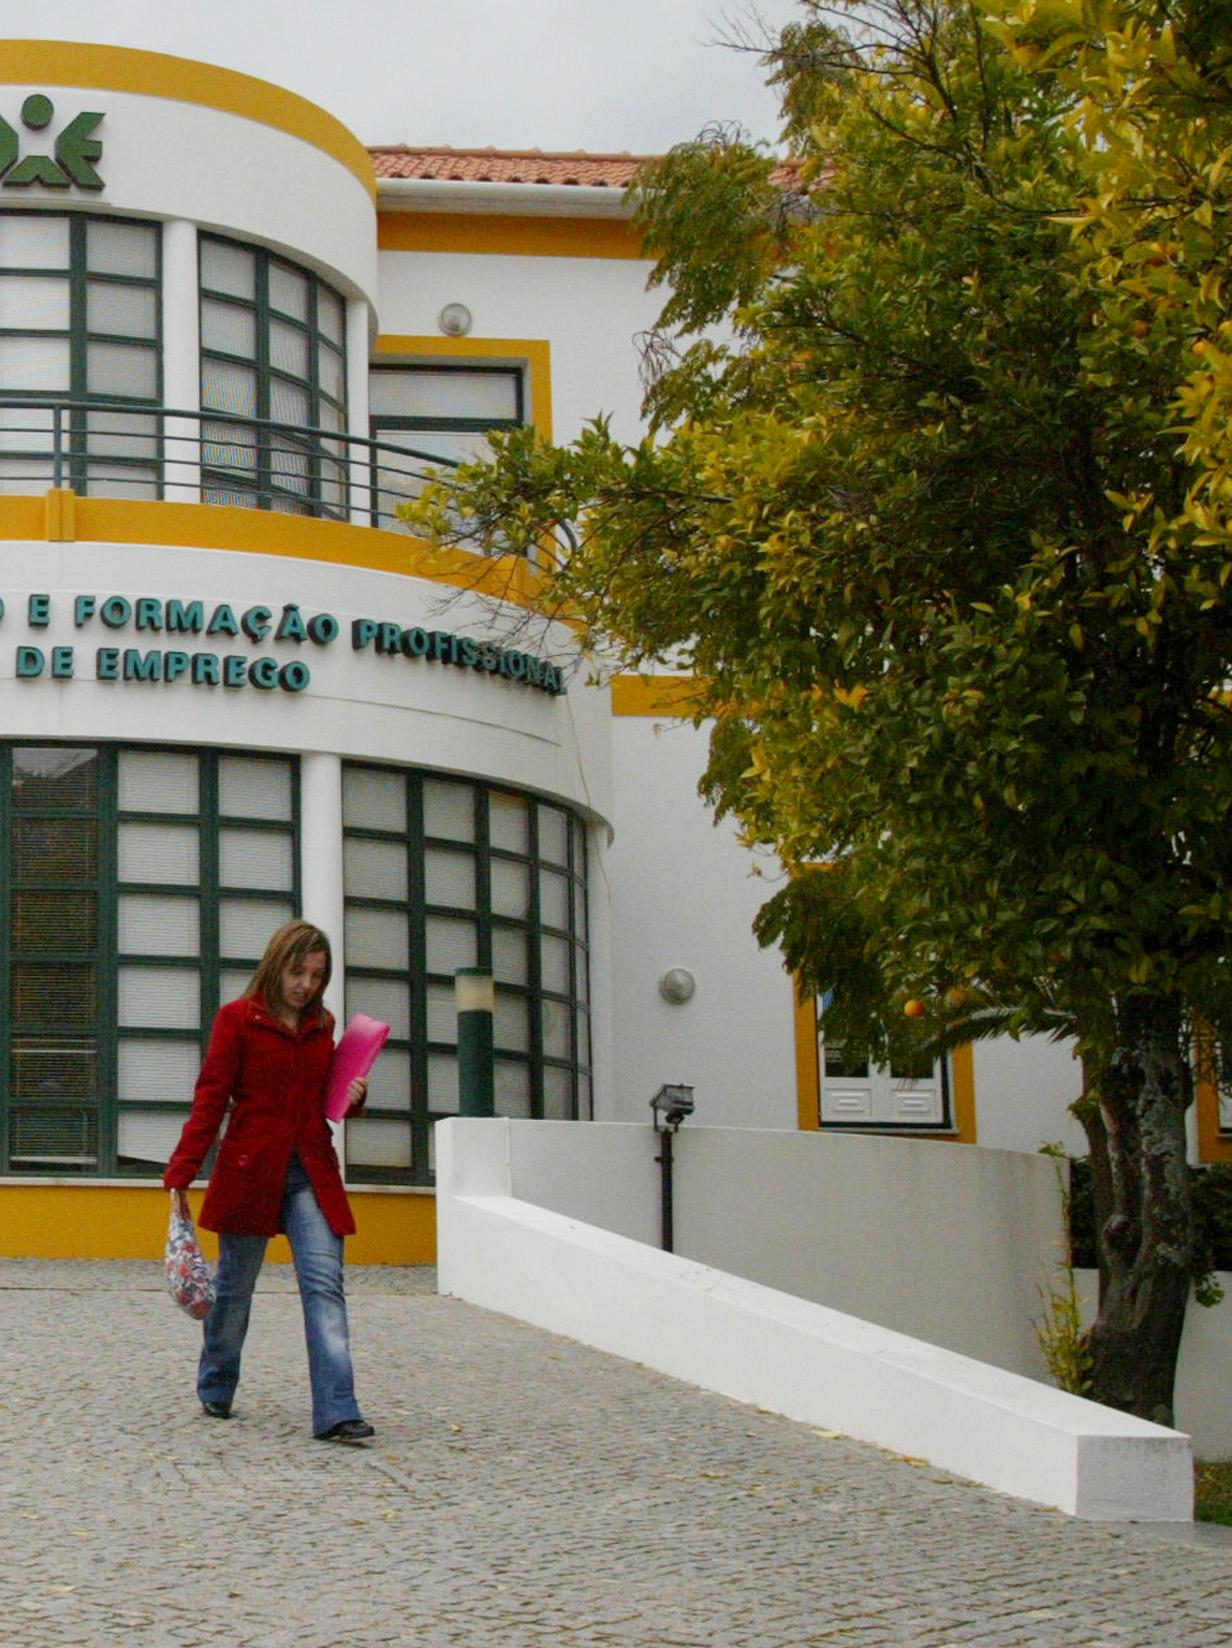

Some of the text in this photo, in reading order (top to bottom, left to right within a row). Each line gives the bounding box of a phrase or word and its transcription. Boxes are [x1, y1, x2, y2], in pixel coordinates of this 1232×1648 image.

[16, 646, 74, 679] DE
[96, 646, 311, 692] EMPREGO
[28, 593, 51, 627] E
[74, 593, 339, 645] FORMAÇÃO
[352, 618, 567, 696] PROFISSIONAL
